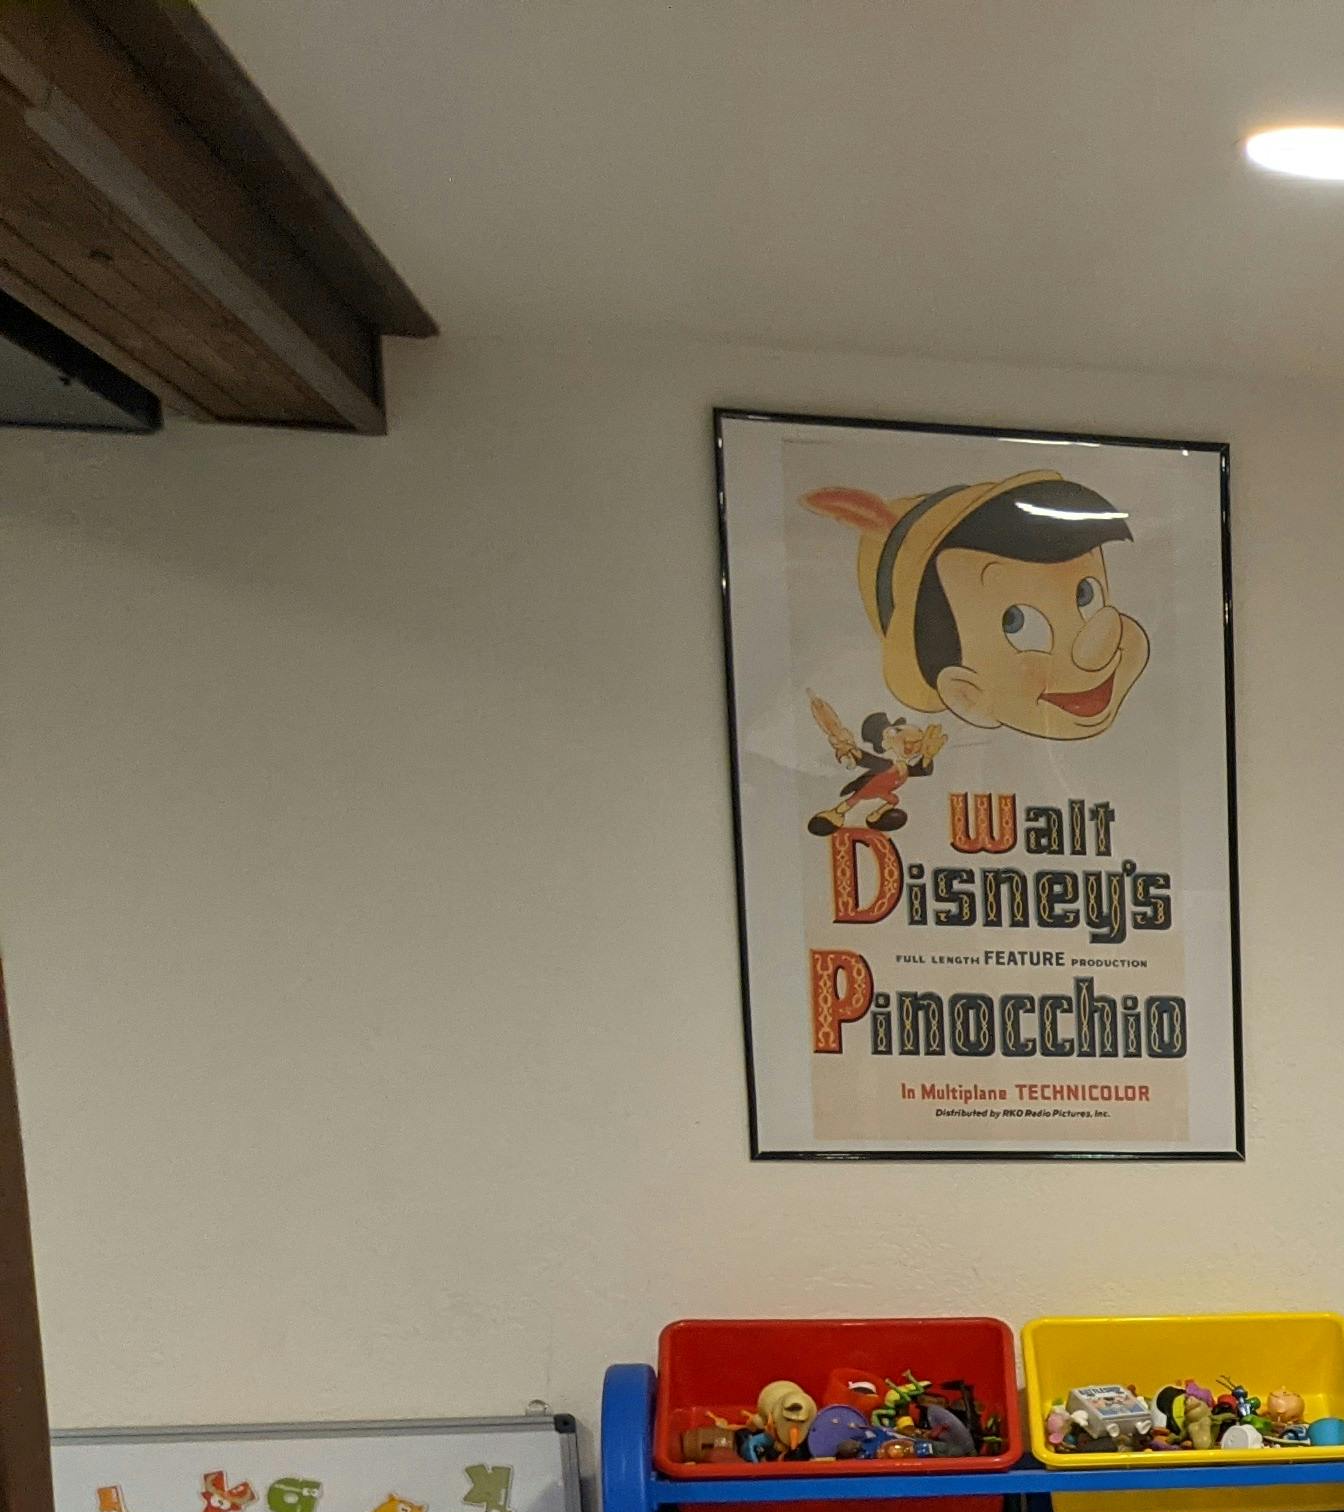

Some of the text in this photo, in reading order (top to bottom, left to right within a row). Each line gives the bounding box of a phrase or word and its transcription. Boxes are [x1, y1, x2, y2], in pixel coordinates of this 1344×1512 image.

[950, 792, 1116, 856] Walt
[831, 826, 1173, 944] Disney's
[896, 950, 1148, 968] FULL LENGTH FEATURE PRODUCTION
[810, 948, 1188, 1058] Pinocchio
[901, 1082, 1151, 1104] In Multiplane TECHNICOLOR
[935, 1108, 988, 1118] Distributed
[989, 1109, 1000, 1119] by
[1002, 1109, 1024, 1118] RKO
[1024, 1109, 1051, 1118] Radio
[1094, 1110, 1111, 1118] Inc.
